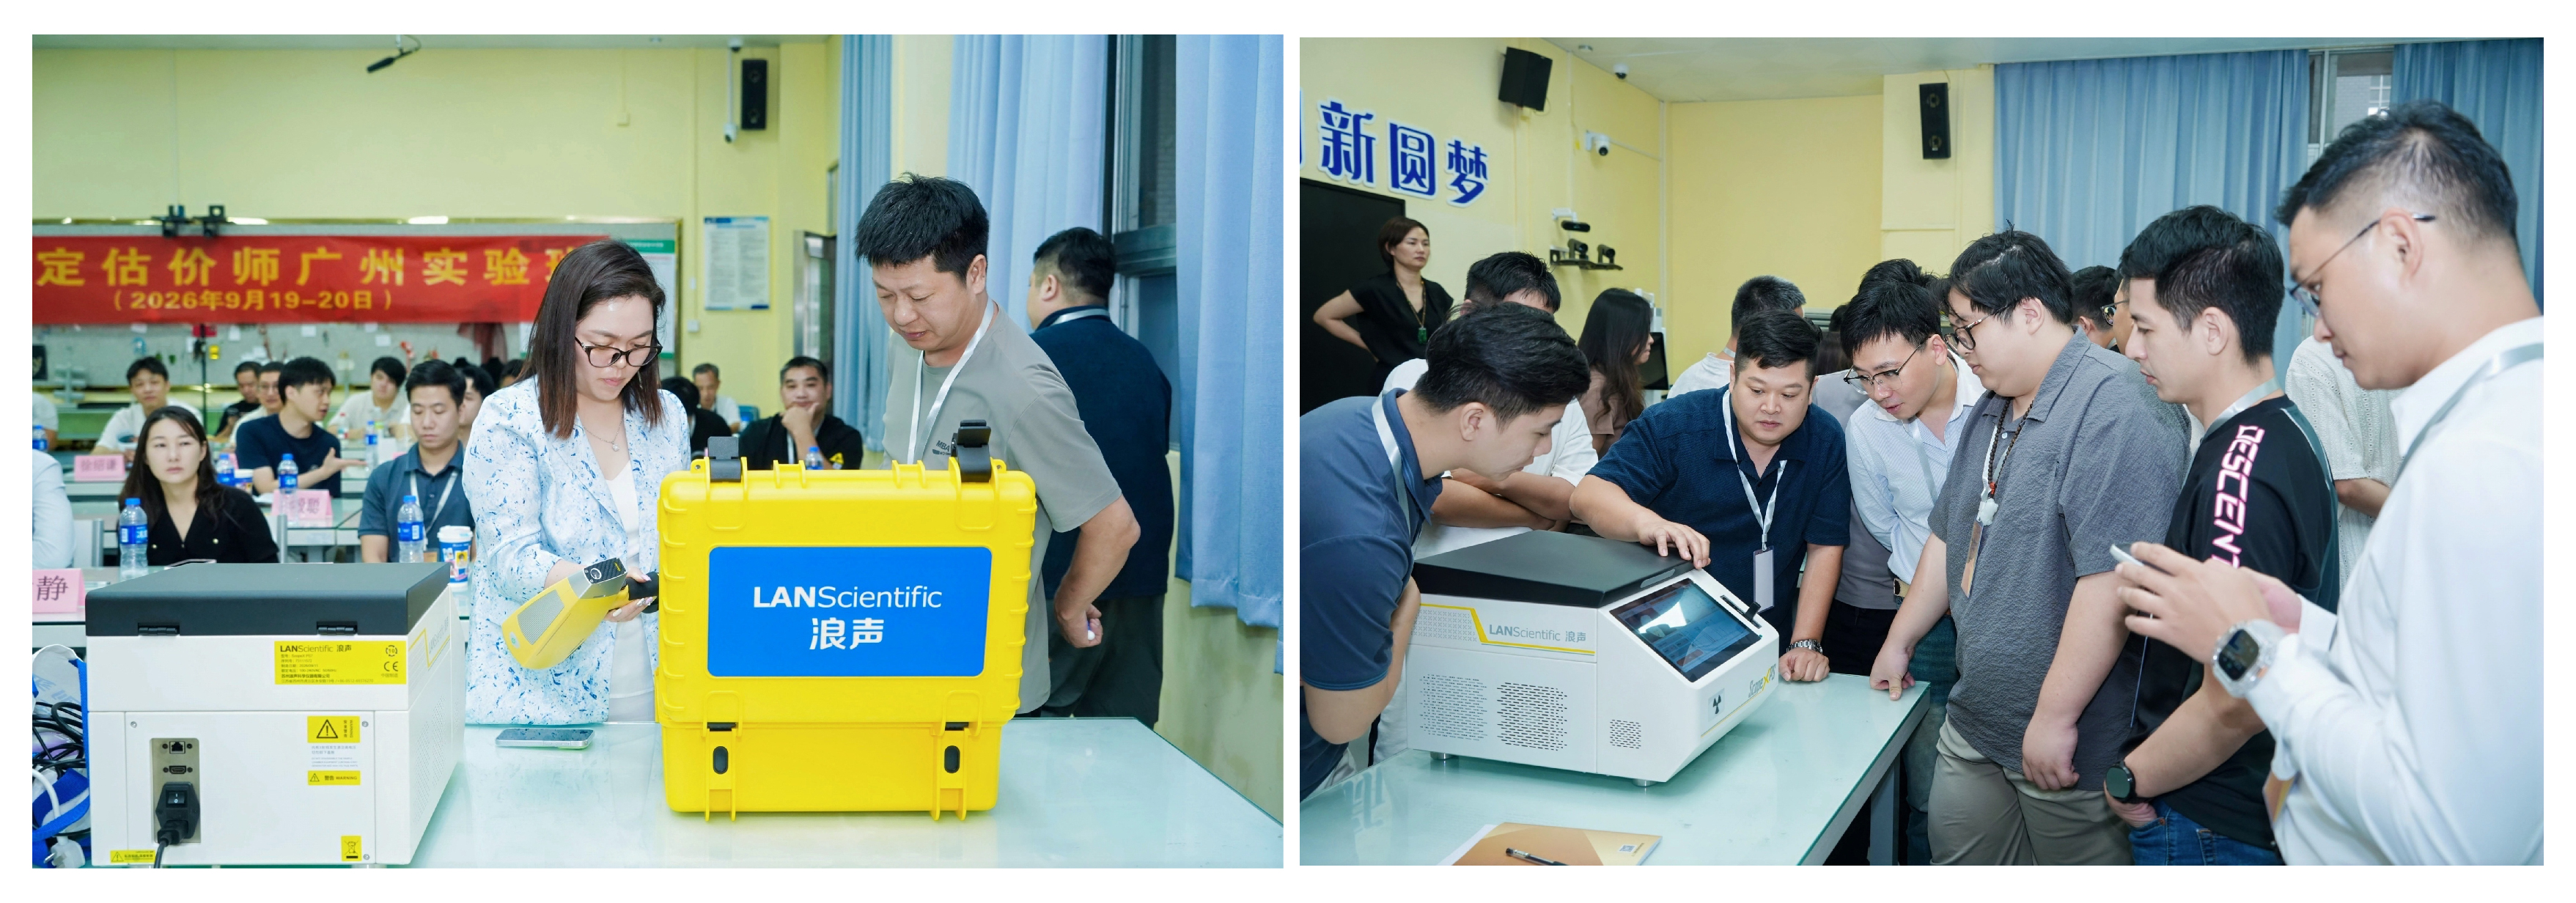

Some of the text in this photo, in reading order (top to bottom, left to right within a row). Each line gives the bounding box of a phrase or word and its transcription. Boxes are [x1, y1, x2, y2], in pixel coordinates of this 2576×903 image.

[1300, 89, 1489, 204] 新圆梦
[754, 585, 943, 608] LANScientific
[809, 617, 885, 650] 浪声
[1489, 624, 1586, 643] LANScientific 浪声
[280, 644, 352, 652] LANScientific 浪声
